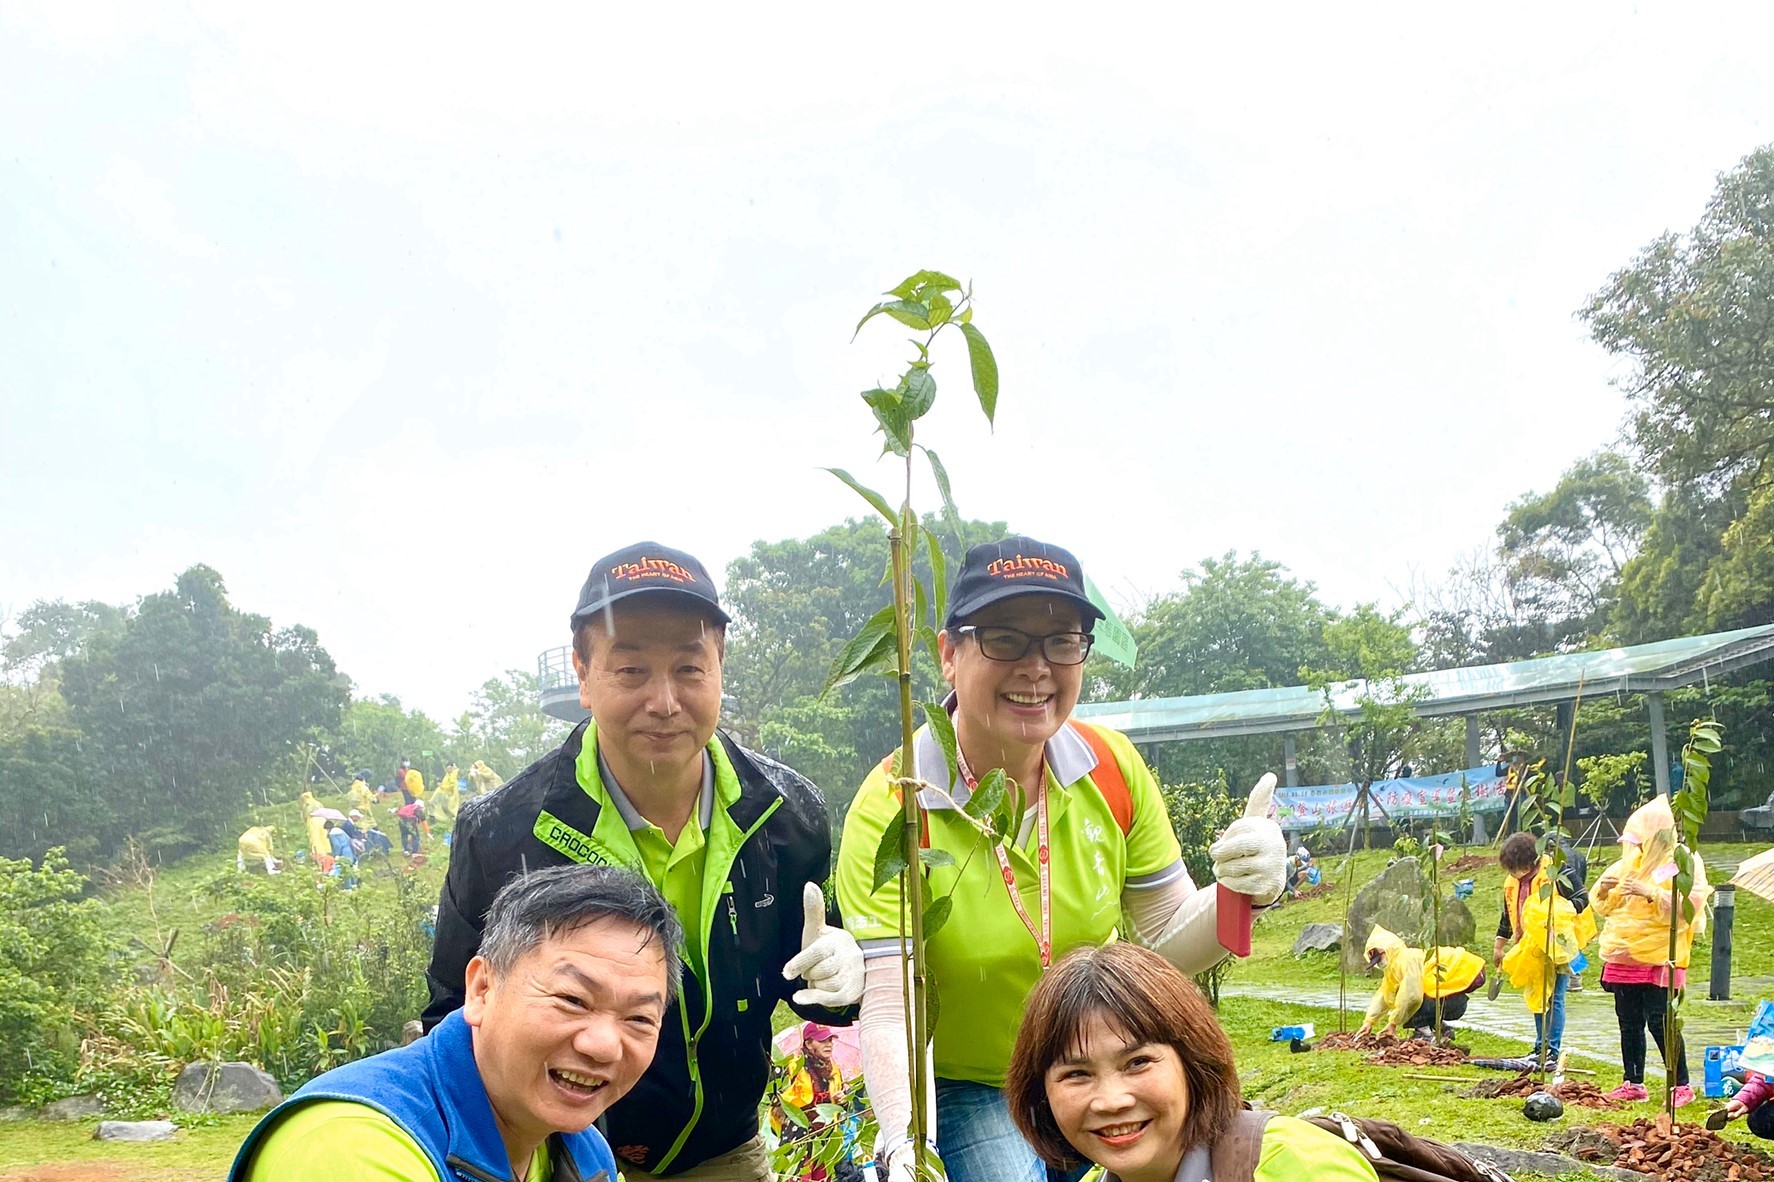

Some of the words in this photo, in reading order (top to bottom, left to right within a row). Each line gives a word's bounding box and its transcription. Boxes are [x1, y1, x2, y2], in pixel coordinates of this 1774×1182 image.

[611, 556, 696, 582] Taiwan
[987, 554, 1069, 579] Taiwan
[549, 826, 612, 867] CROCOD
